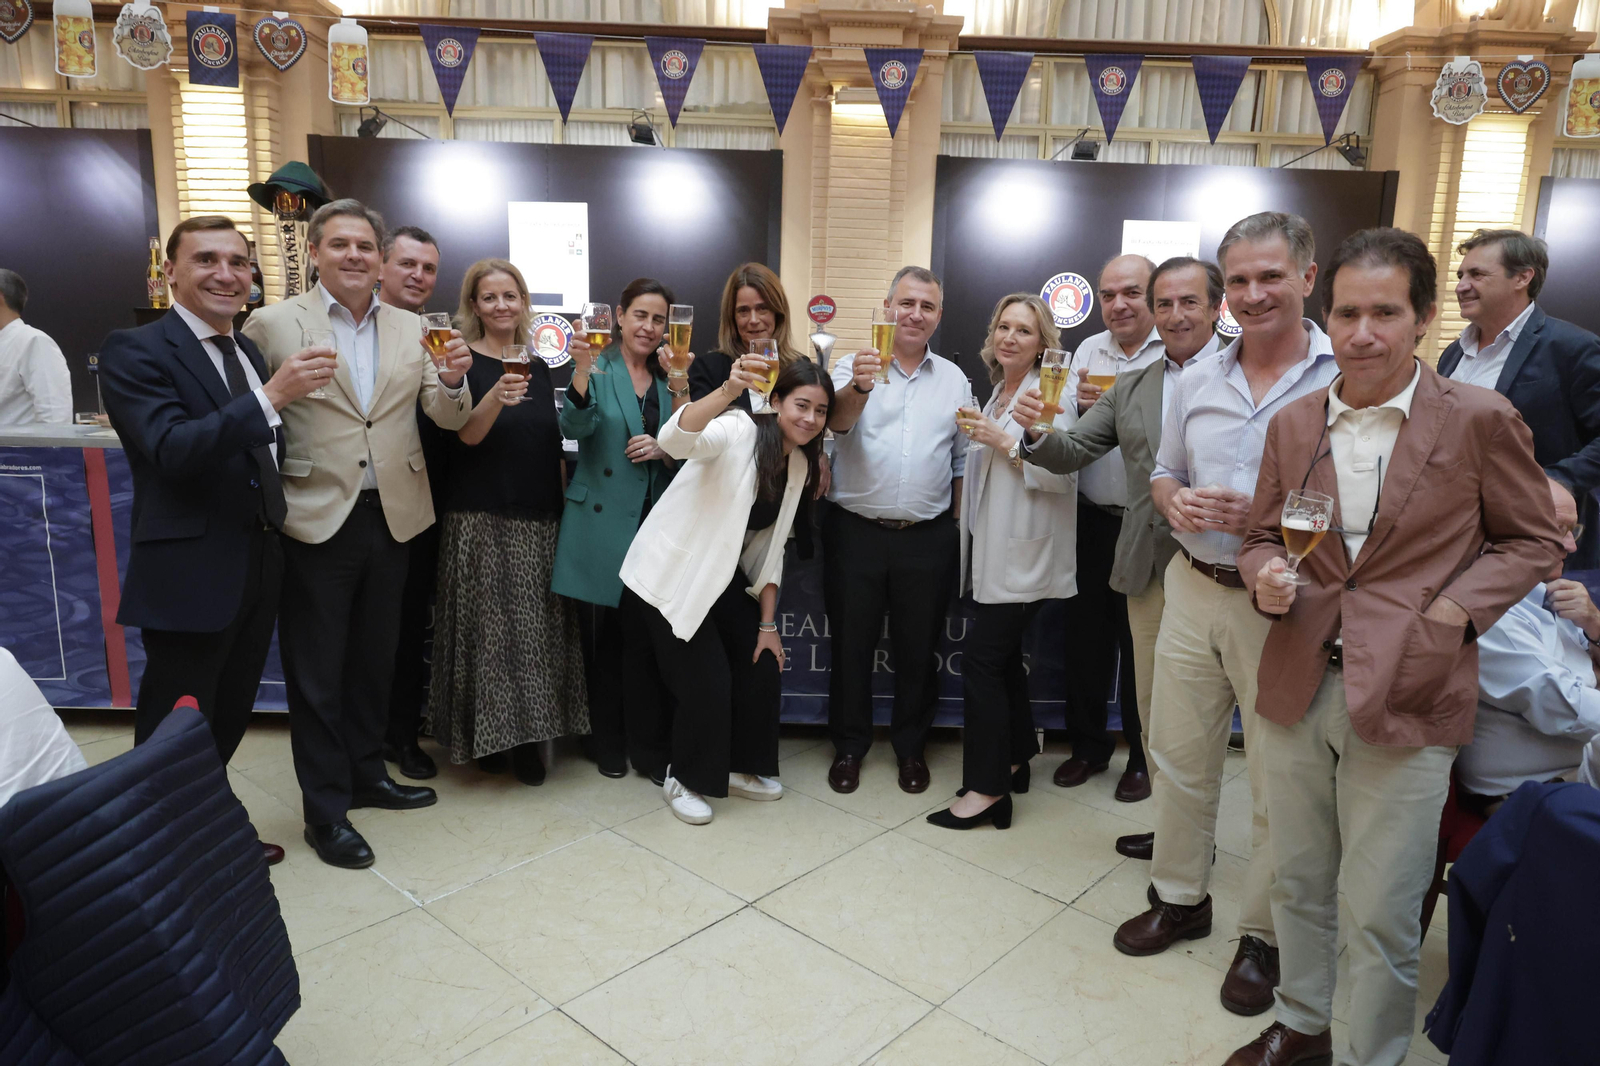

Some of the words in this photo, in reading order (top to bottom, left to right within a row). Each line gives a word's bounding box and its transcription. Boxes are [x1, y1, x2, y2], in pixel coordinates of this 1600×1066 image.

[194, 26, 229, 43] PAULANER
[438, 40, 461, 50] PAULANER
[663, 51, 686, 62] PAULANER
[882, 61, 905, 72] PAULANER
[1101, 68, 1124, 78] PAULANER
[1321, 70, 1344, 80] PAULANER
[283, 221, 300, 296] PAULANER
[1044, 275, 1089, 296] PAULANER
[1312, 519, 1325, 529] 13
